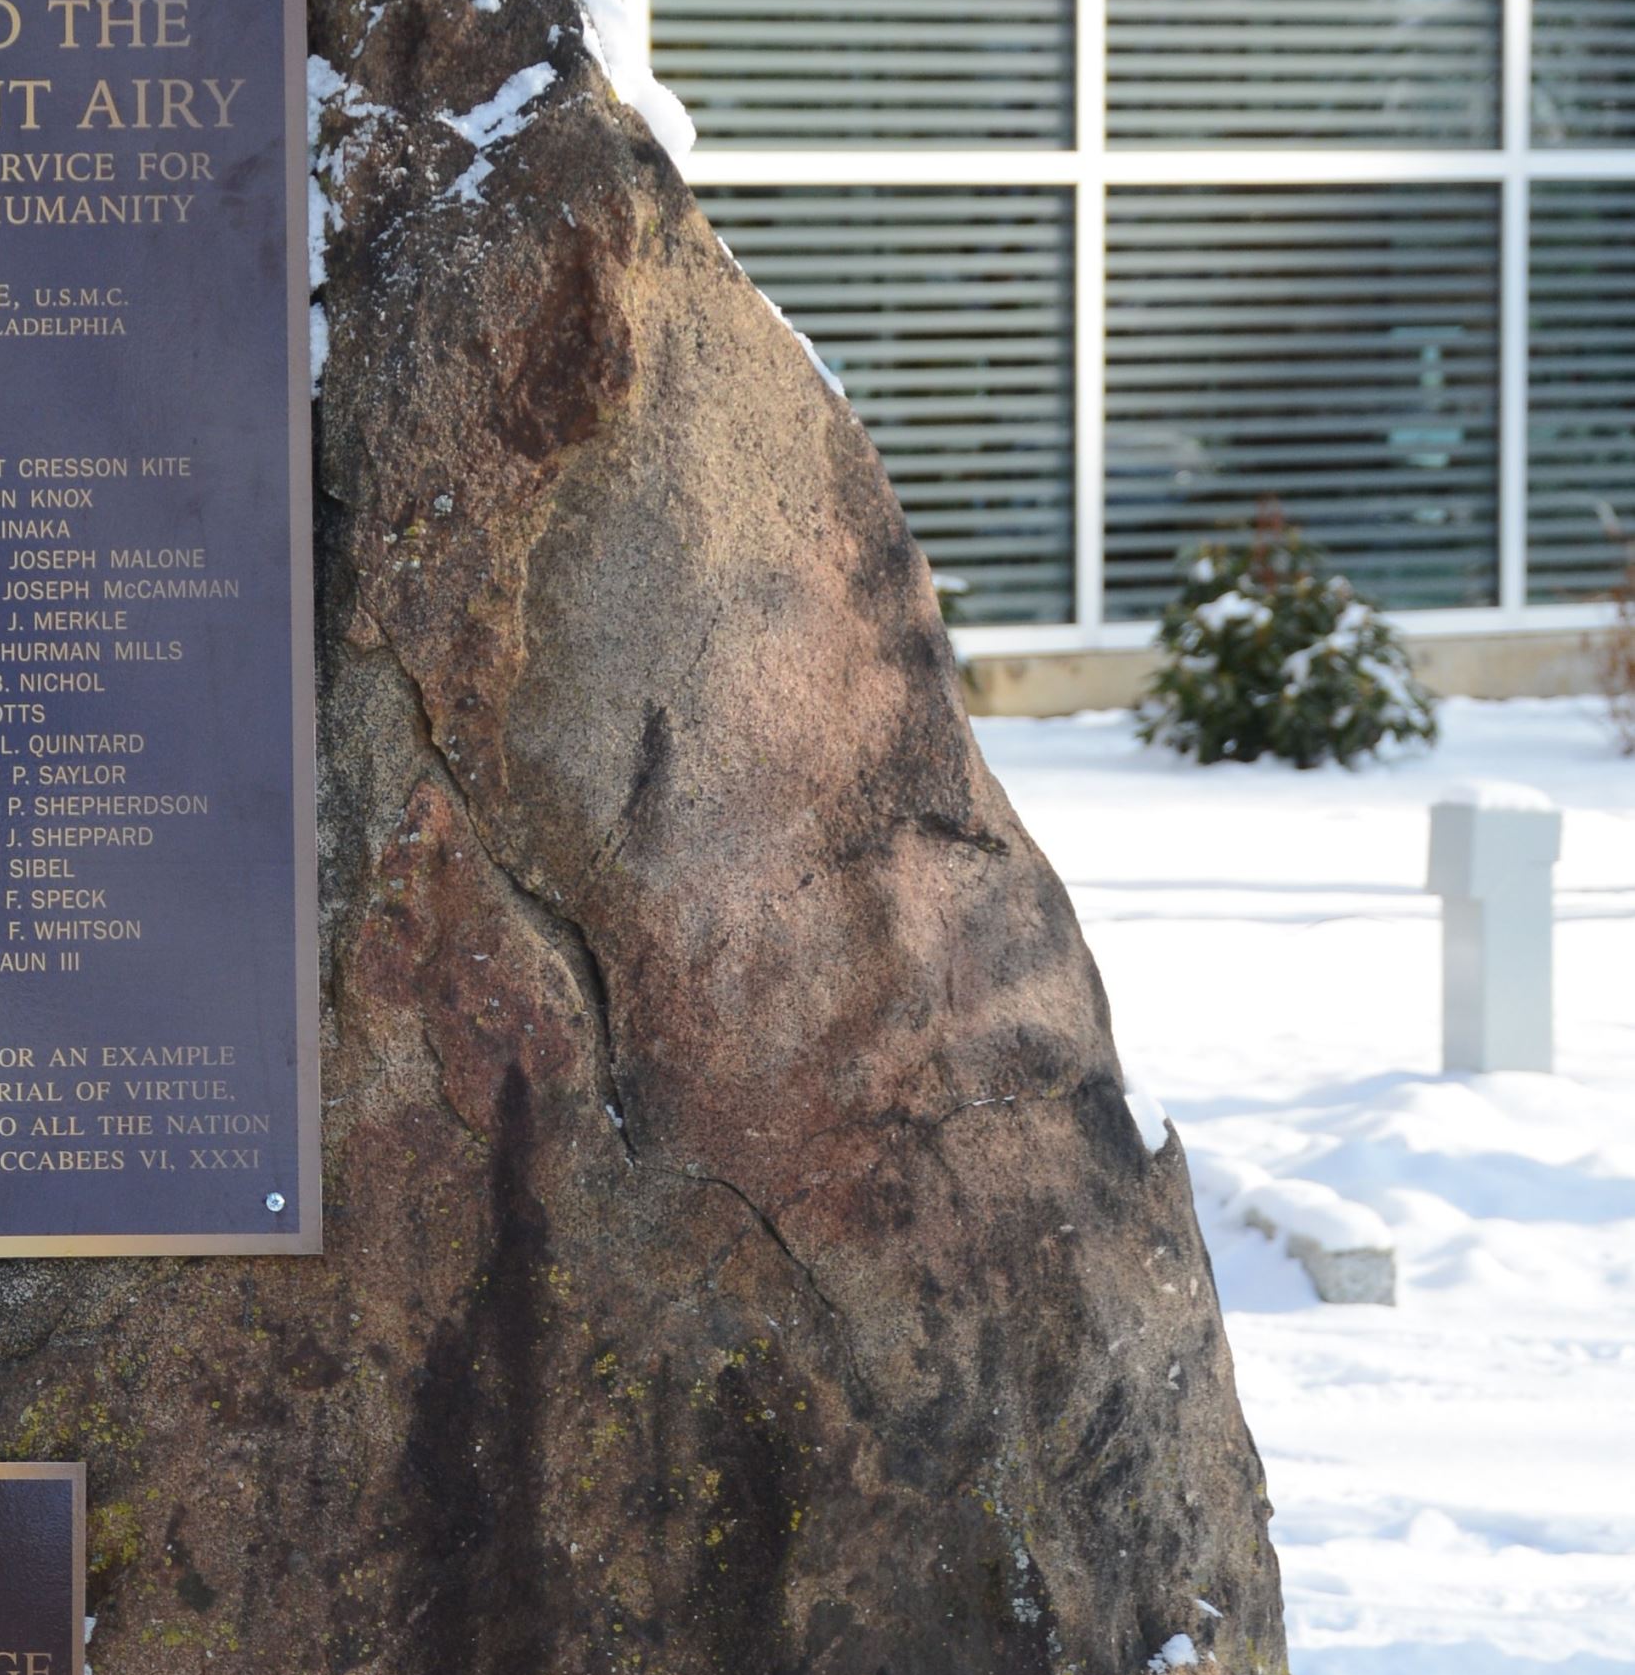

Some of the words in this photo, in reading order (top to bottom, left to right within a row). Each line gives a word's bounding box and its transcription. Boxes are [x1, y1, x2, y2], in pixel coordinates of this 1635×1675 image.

[48, 0, 190, 48] THE
[76, 79, 245, 129] AIRY
[138, 152, 214, 182] FOR
[35, 288, 128, 308] U.S.M.C.
[19, 458, 127, 478] CRESSON
[142, 457, 190, 476] KITE
[31, 489, 93, 508] KNOX
[9, 550, 95, 570] JOSEPH
[111, 549, 205, 568] MALONE
[2, 581, 89, 600] JOSEPH
[104, 580, 238, 599] McCAMMAN
[8, 612, 23, 631] J.
[34, 611, 127, 630] MERKLE
[115, 641, 182, 660] MILLS
[20, 673, 105, 692] NICHOL
[1, 735, 19, 754] L.
[29, 734, 144, 758] QUINTARD
[13, 766, 29, 785] P.
[39, 765, 125, 785] SAYLOR
[9, 797, 25, 816] P.
[34, 795, 207, 816] SHEPHERDSON
[6, 828, 22, 847] J.
[31, 827, 153, 847] SHEPPARD
[10, 859, 75, 878] SIBEL
[7, 890, 21, 909] F.
[31, 890, 106, 909] SPECK
[9, 922, 24, 940] F.
[34, 920, 140, 940] WHITSON
[61, 952, 79, 971] III
[49, 1048, 87, 1067] AN
[102, 1046, 235, 1066] EXAMPLE
[76, 1082, 110, 1101] OF
[124, 1081, 234, 1100] VIRTUE,
[30, 1117, 84, 1136] ALL
[98, 1116, 153, 1135] THE
[166, 1115, 269, 1134] NATION
[139, 1150, 174, 1171] VI,
[190, 1149, 258, 1169] XXXI
